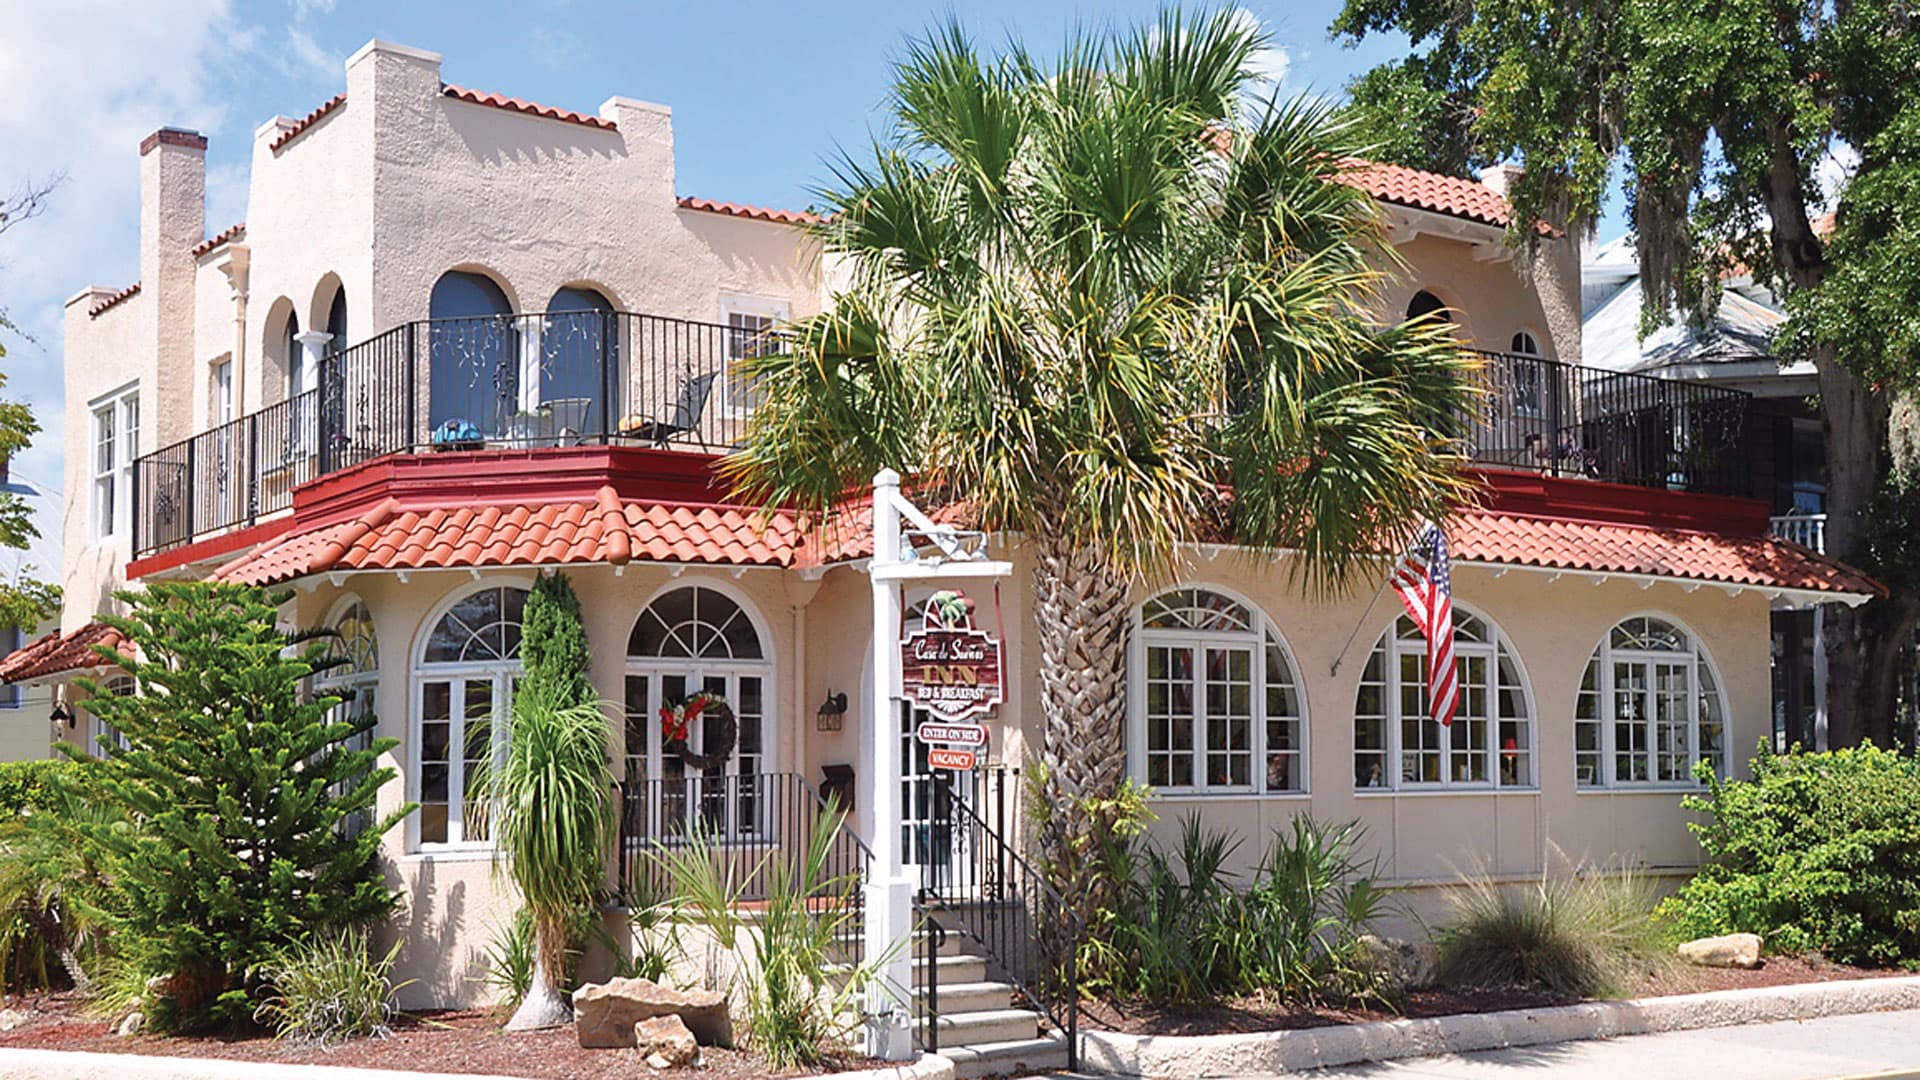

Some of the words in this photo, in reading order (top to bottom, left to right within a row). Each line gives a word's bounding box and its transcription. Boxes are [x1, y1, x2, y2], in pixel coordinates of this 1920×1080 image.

[922, 665, 977, 685] INN
[941, 687, 985, 700] BREAKFAST
[923, 728, 947, 738] ENTER
[948, 729, 960, 740] ON
[932, 753, 970, 766] VACANCY
